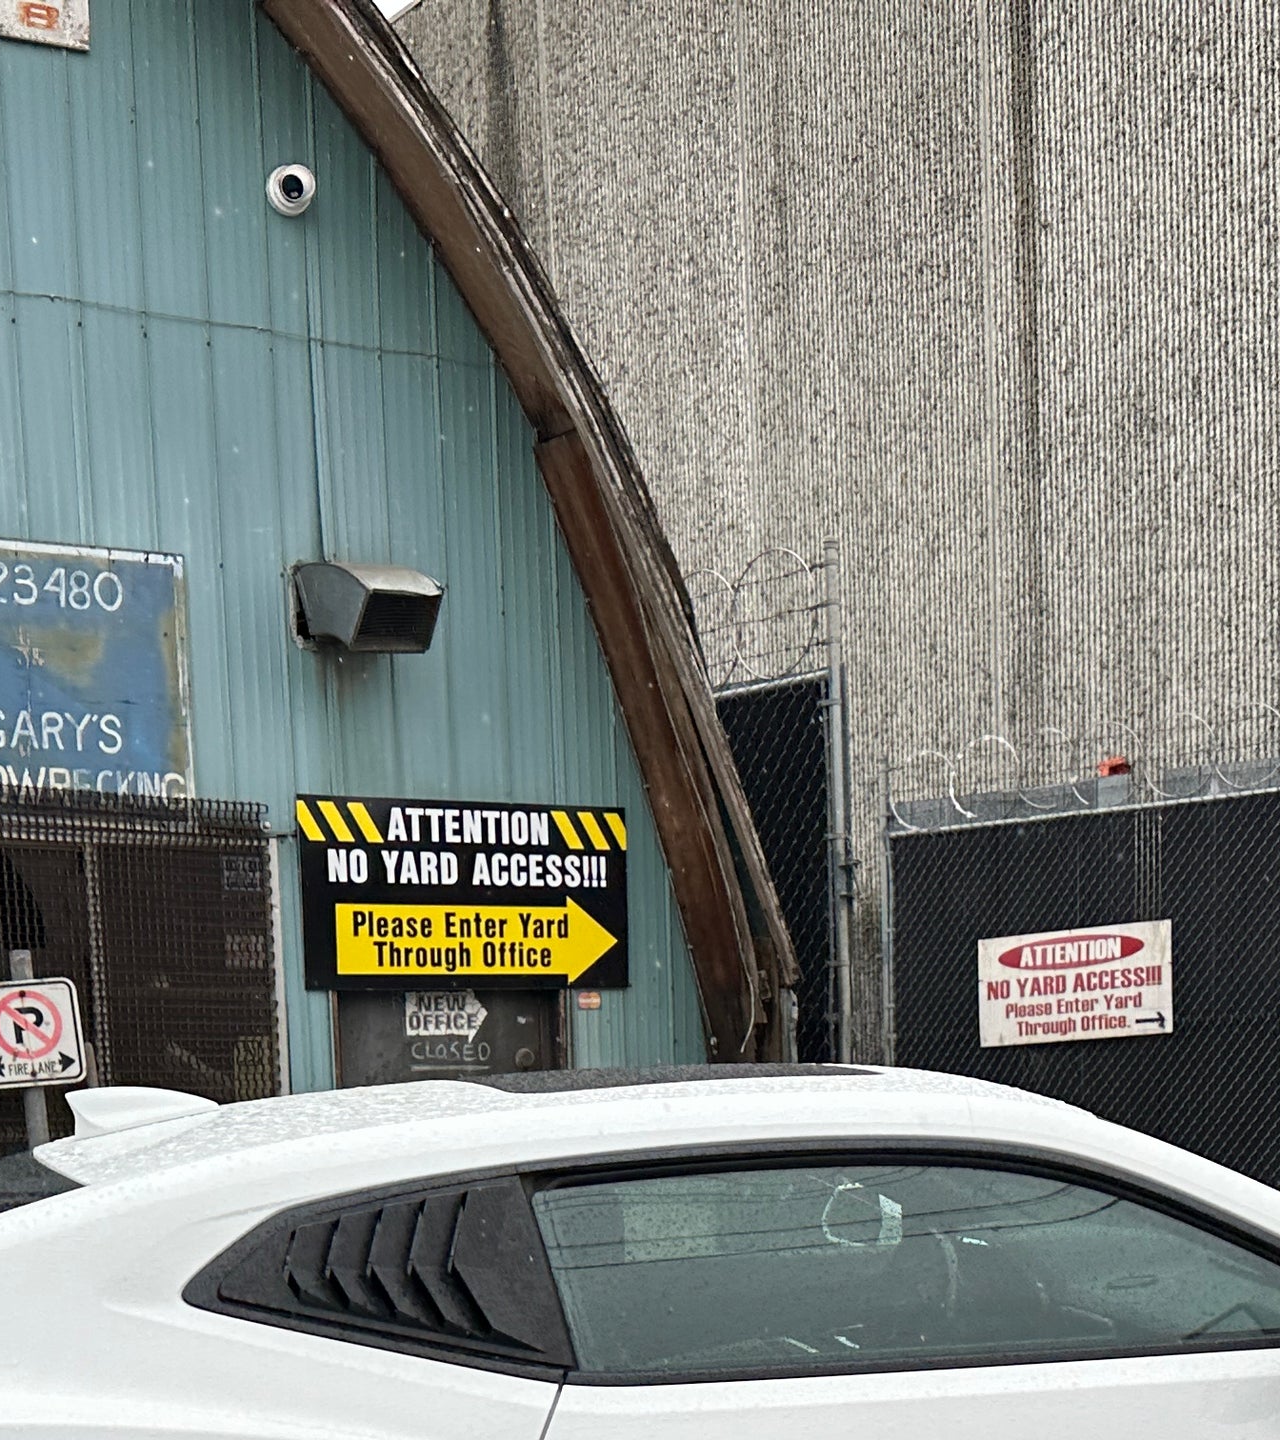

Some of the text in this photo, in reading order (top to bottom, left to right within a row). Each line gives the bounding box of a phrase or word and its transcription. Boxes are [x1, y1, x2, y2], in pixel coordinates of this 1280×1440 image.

[387, 807, 550, 846] ATTENTION
[327, 848, 608, 888] NO YARD ACCESS!!!
[352, 911, 569, 939] Please Enter Yard
[373, 941, 552, 972] Through Office
[1020, 937, 1122, 967] ATTENTION
[987, 965, 1162, 1000] NO YARD ACCESS!!!
[418, 994, 466, 1012] NEW
[1005, 992, 1143, 1019] Please Enter Yard
[408, 1011, 478, 1031] OFFICE
[1017, 1014, 1131, 1036] Through Office.
[411, 1041, 491, 1061] CLOSED
[8, 1060, 59, 1076] FIRE LANE
